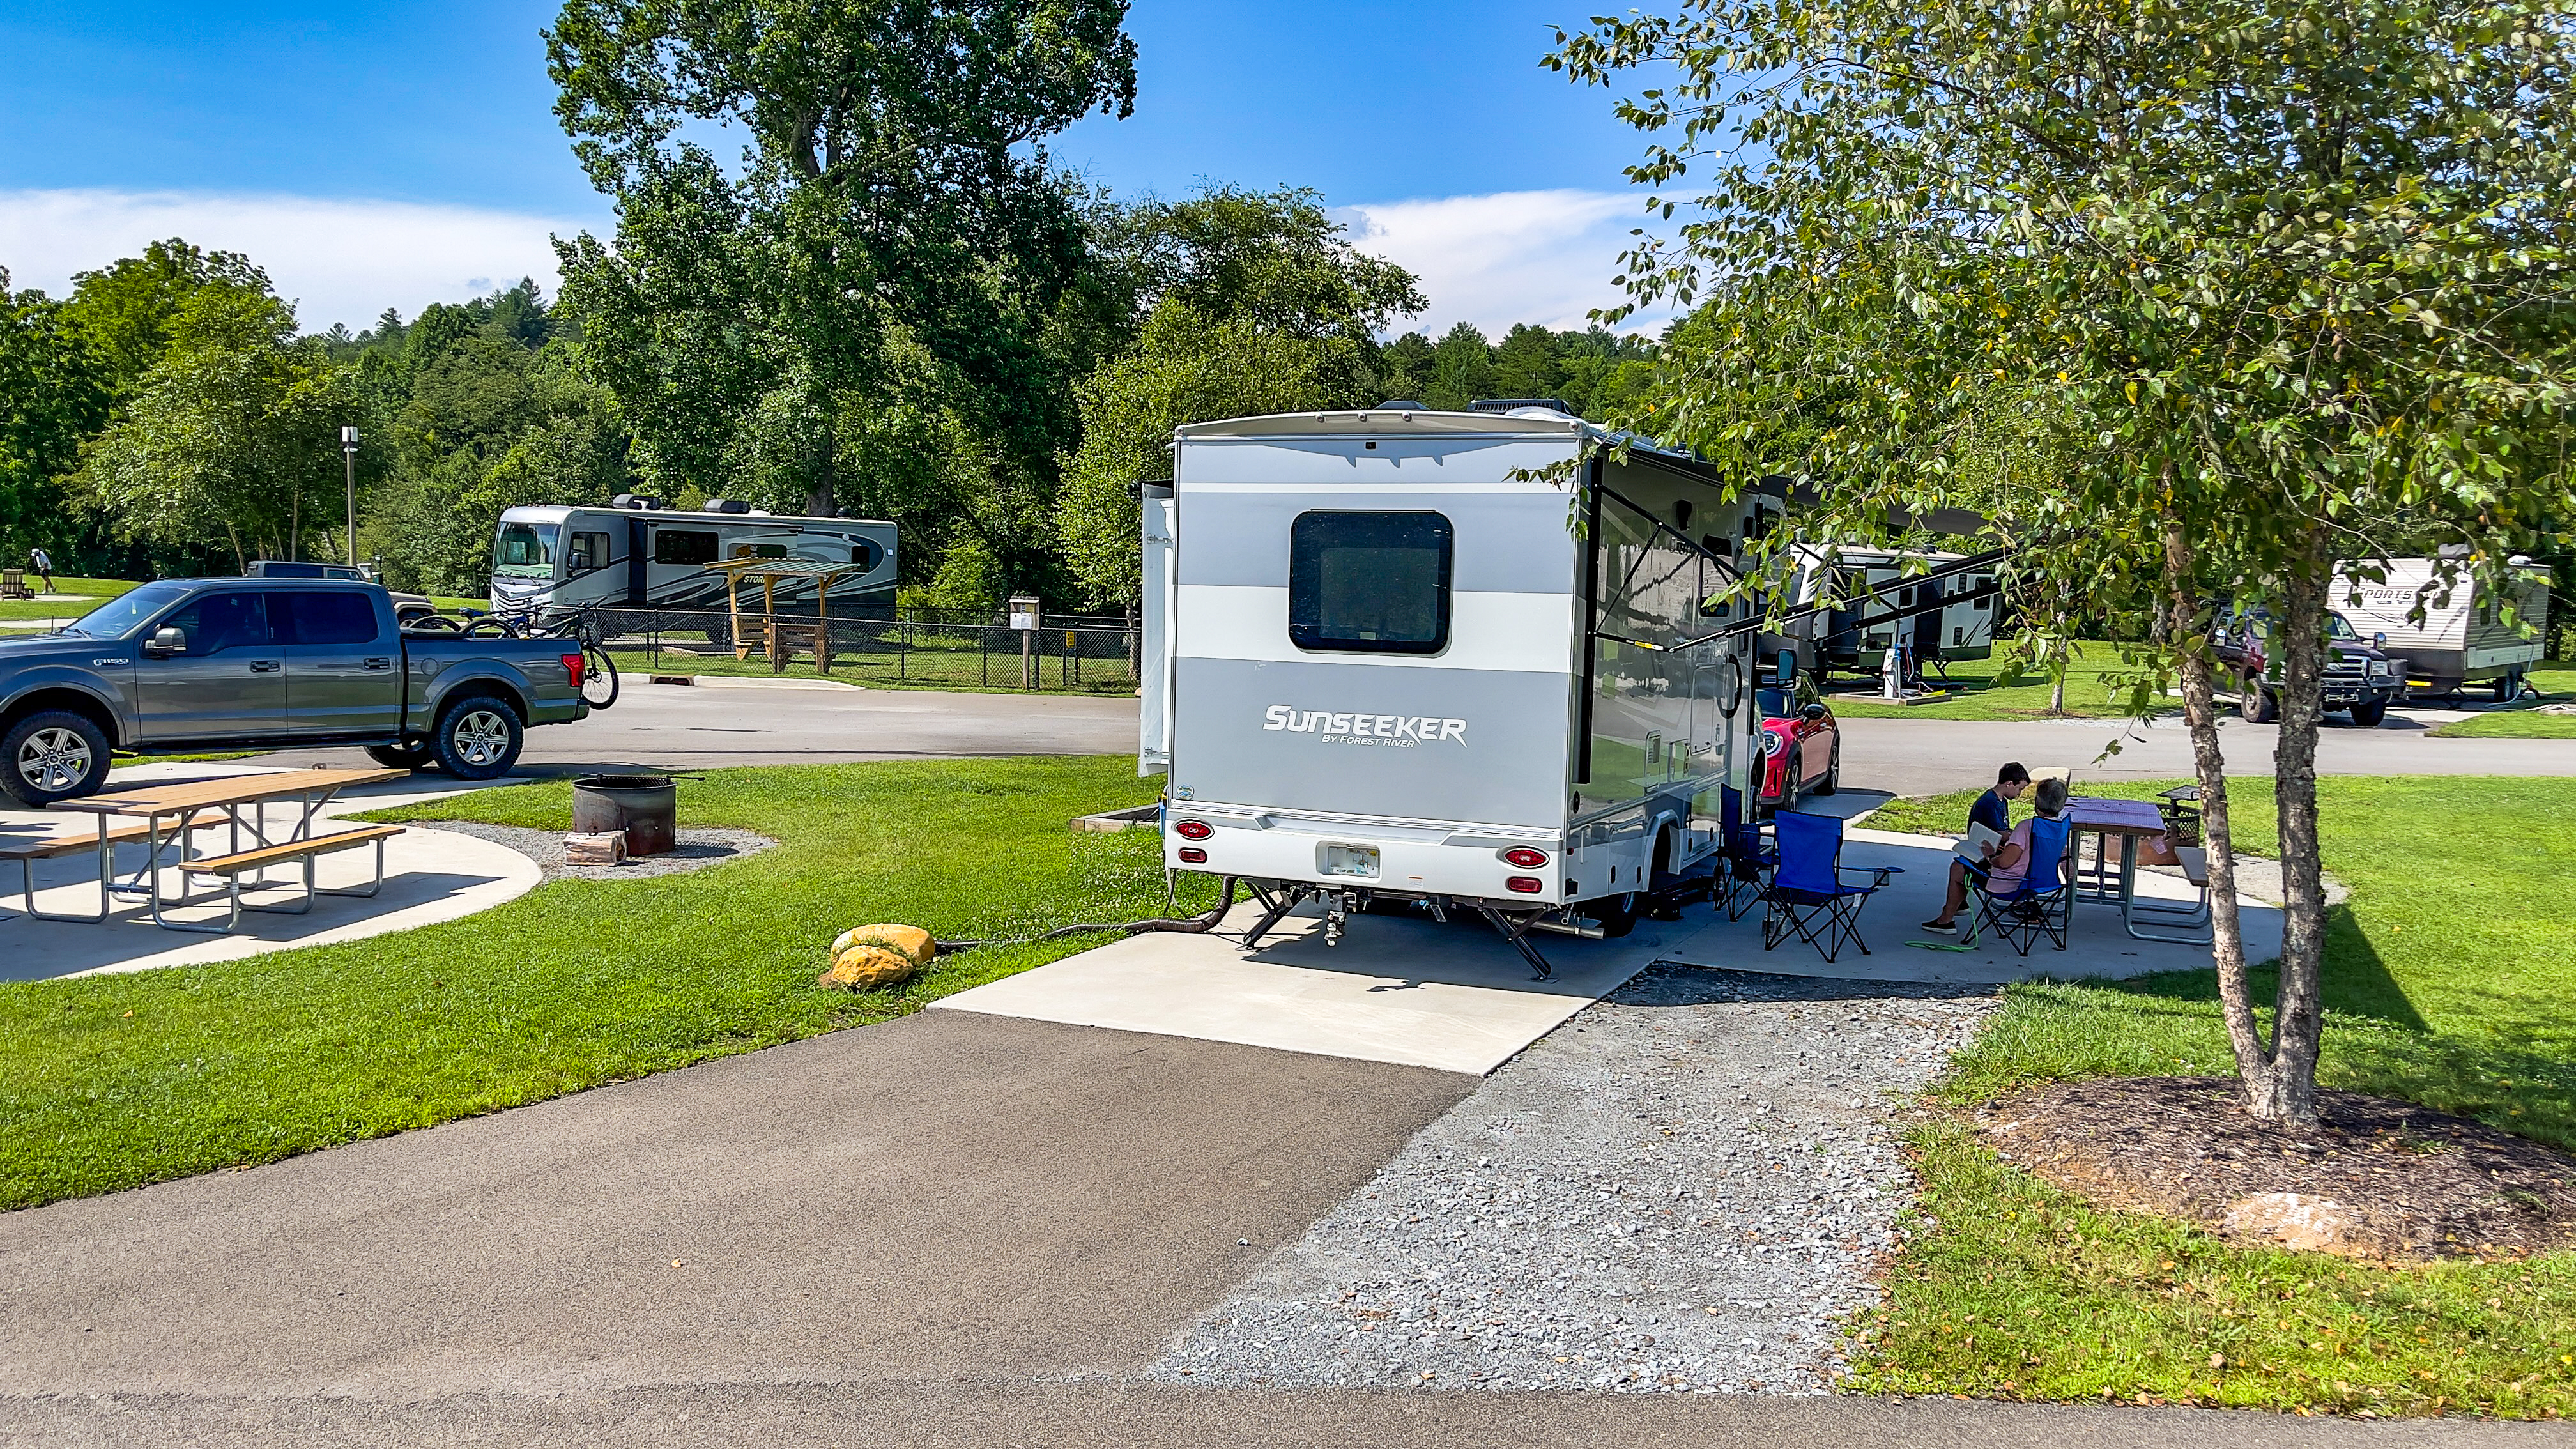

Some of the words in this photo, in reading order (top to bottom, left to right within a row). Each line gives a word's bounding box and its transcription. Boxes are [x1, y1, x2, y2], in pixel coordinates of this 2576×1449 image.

[1262, 704, 1468, 749] SUNSEEKER
[1321, 734, 1337, 744] BY
[1339, 735, 1381, 746] FOREST
[1383, 738, 1416, 748] RIVER
